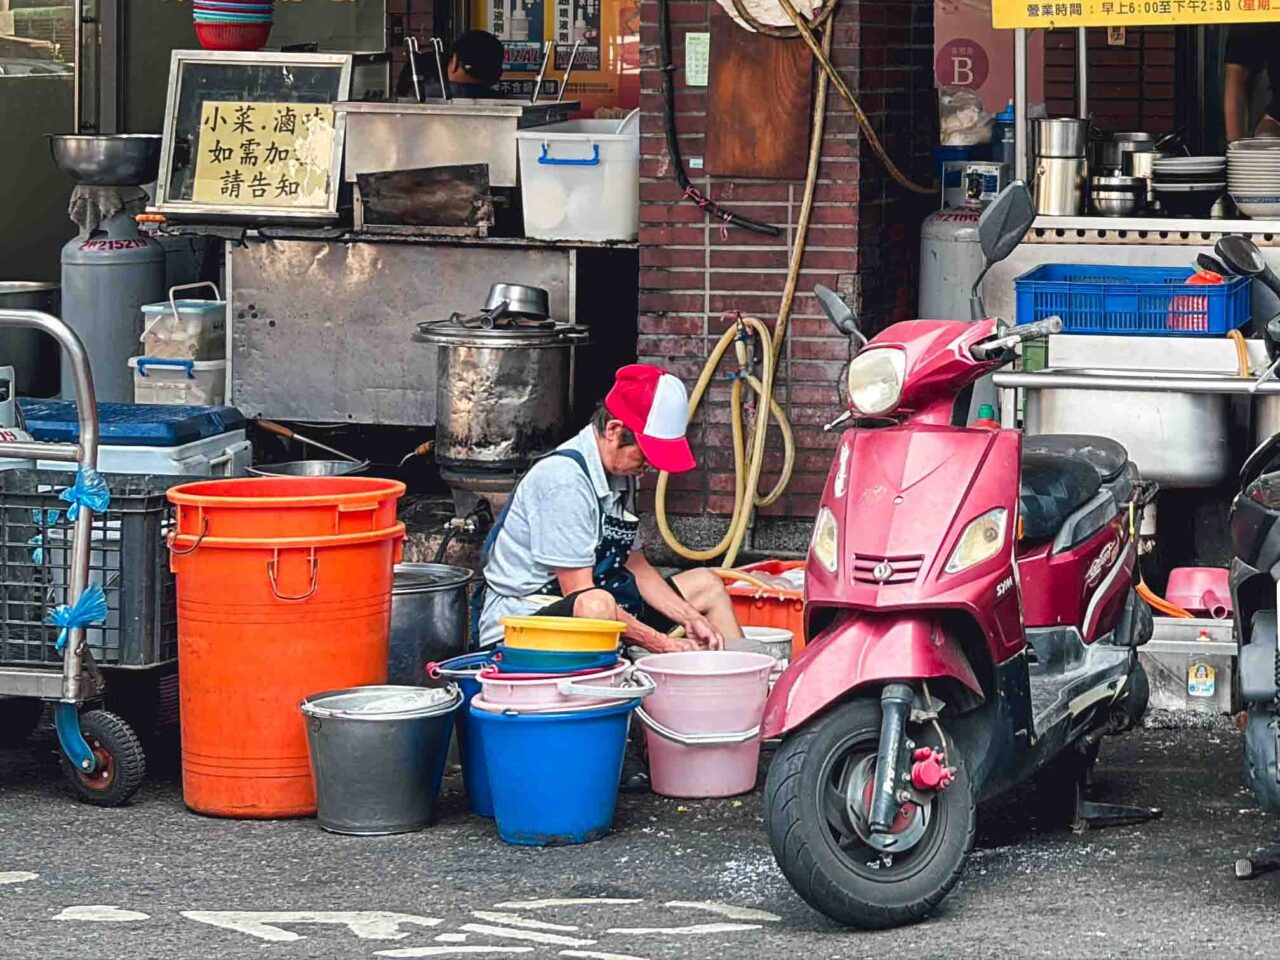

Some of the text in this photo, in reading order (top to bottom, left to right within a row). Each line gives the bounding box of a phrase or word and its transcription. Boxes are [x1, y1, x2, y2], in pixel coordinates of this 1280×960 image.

[951, 57, 973, 85] B
[208, 138, 306, 167] 如需加
[219, 170, 302, 199] 請告知
[996, 575, 1013, 597] SYM
